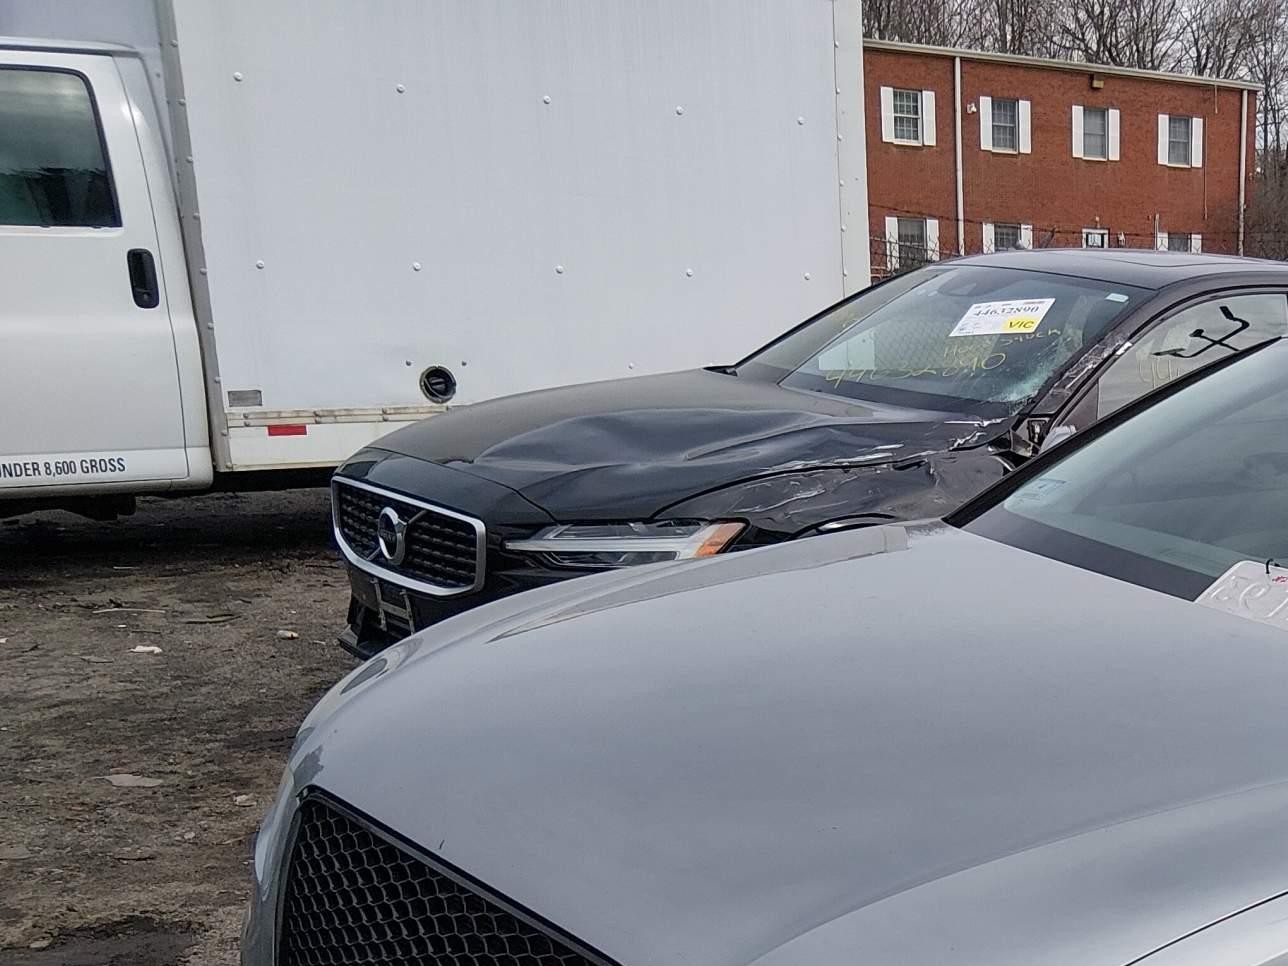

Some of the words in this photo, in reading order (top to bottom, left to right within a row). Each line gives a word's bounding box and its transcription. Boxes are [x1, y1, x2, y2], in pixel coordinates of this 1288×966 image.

[1008, 320, 1035, 329] VIC
[0, 462, 41, 478] NDER
[44, 460, 77, 477] 8,600
[80, 457, 126, 474] GROSS
